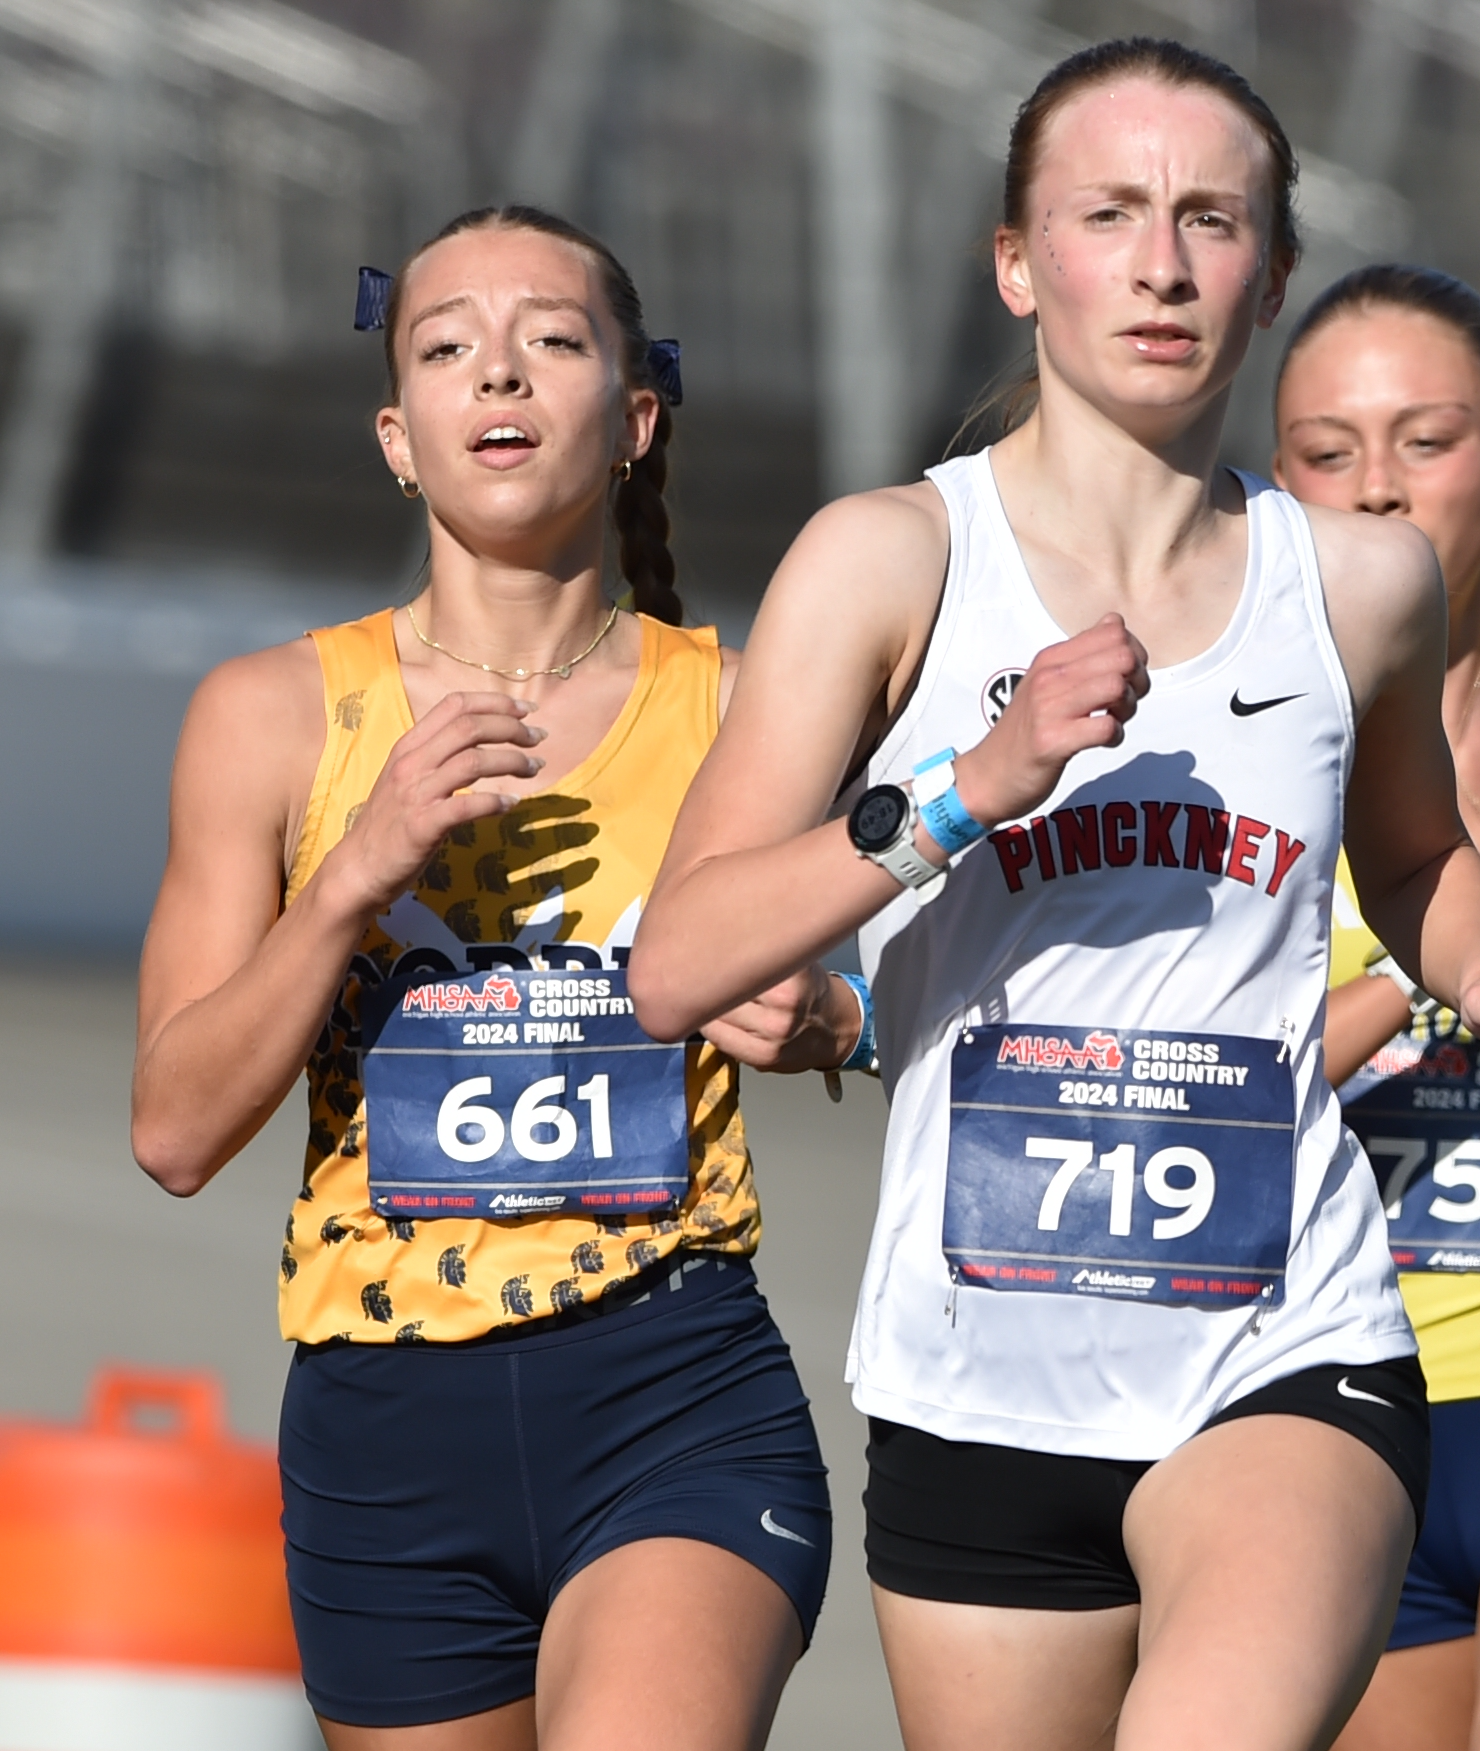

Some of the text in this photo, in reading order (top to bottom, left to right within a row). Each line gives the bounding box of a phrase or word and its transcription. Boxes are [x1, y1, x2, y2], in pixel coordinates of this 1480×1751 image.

[988, 800, 1306, 898] PINCKNEY
[402, 979, 611, 1012] MHSAA CROSS
[463, 1022, 585, 1044] 2024 FINAL
[997, 1035, 1219, 1070] MHSAA CROSS
[1132, 1061, 1249, 1086] COUNTRY
[1058, 1081, 1190, 1111] 2024 FINAL
[1413, 1087, 1465, 1109] 2024
[436, 1074, 613, 1162] 661
[1025, 1136, 1216, 1240] 719
